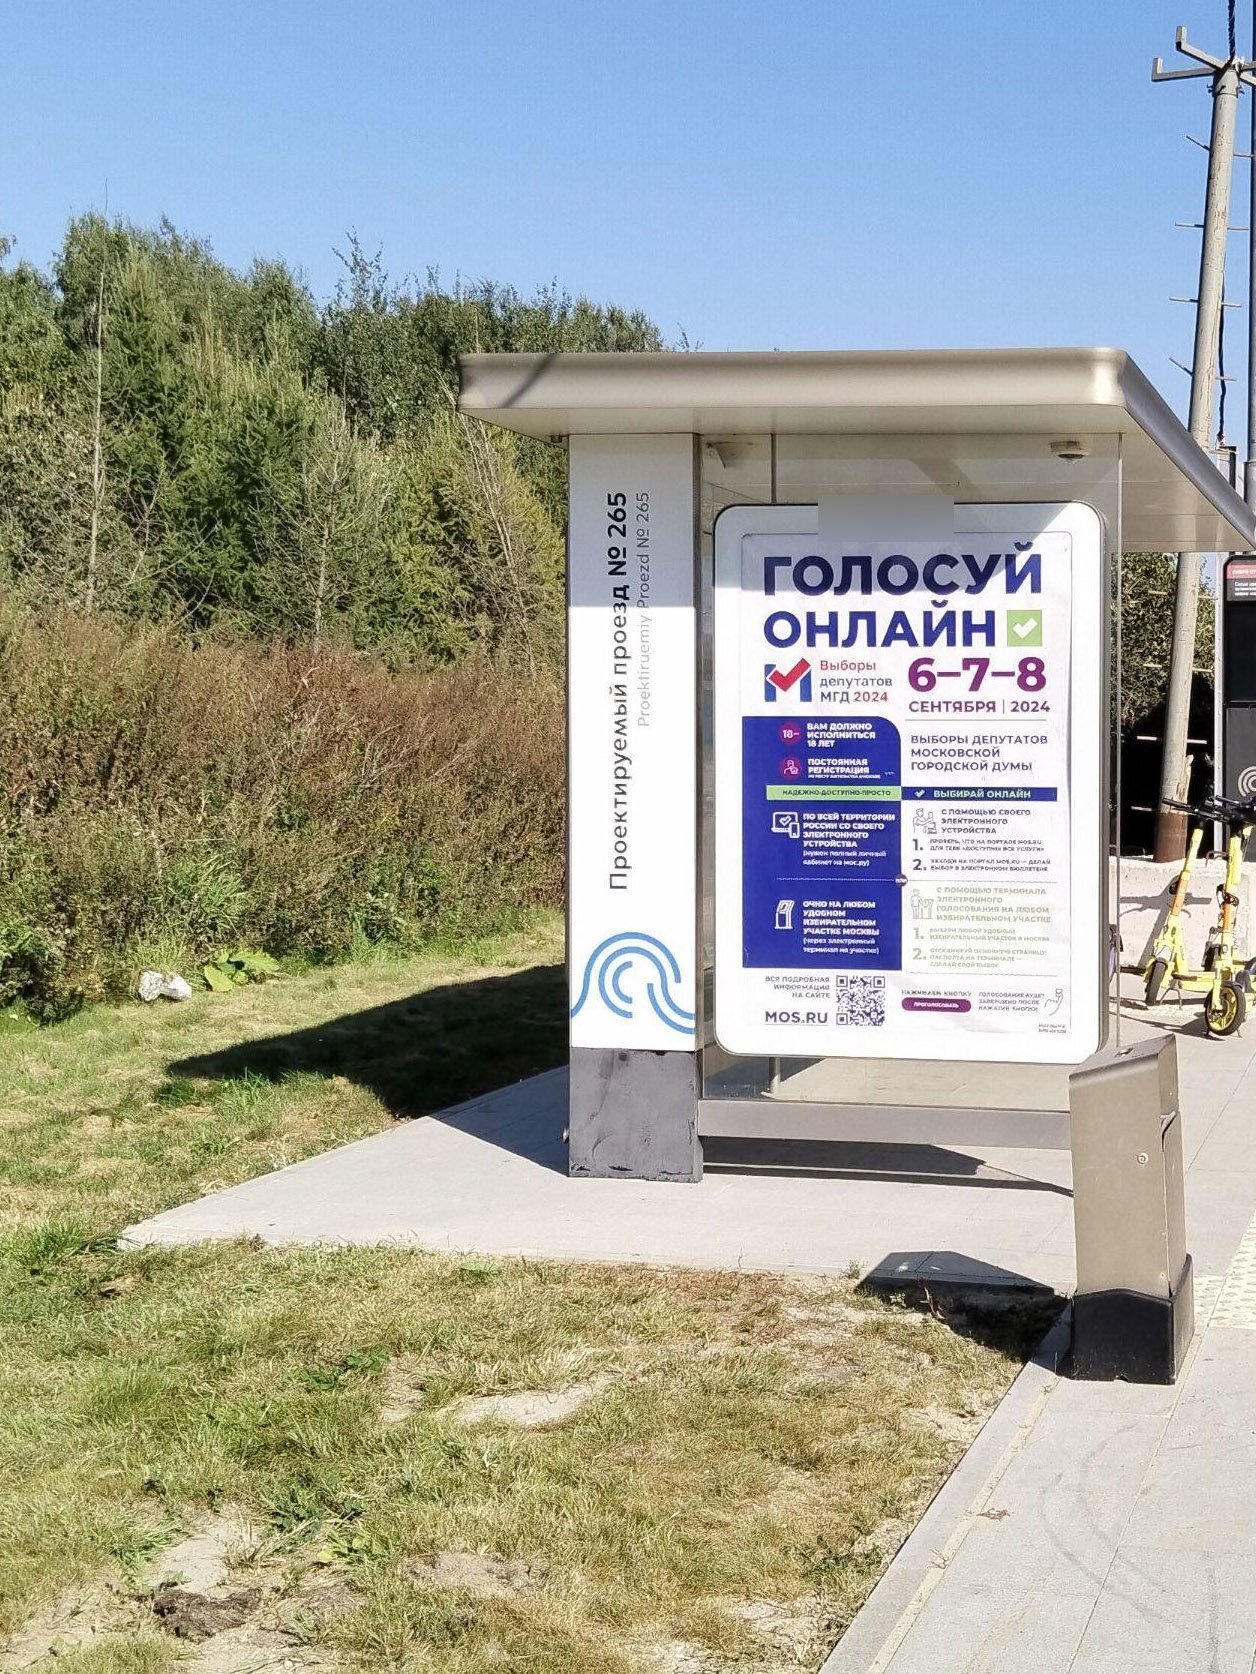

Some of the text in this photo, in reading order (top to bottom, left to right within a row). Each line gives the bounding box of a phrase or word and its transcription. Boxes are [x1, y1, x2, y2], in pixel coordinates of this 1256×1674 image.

[635, 492, 650, 523] 265
[636, 528, 650, 548] №
[763, 541, 1043, 597] ГОЛОСУЙ
[636, 553, 650, 608] Proezd
[763, 600, 996, 648] ОНЛАЙН
[820, 660, 876, 673] Выборы
[820, 677, 893, 689] депутатов
[607, 492, 632, 890] Проектируемый проезд № 265
[820, 691, 889, 704] МГД 2024
[908, 700, 1051, 713] СЕНТЯБРЯ 2024
[830, 723, 872, 731] ДОЛЖНО
[807, 731, 876, 739] ИСПОЛНИТЬСЯ
[911, 735, 1048, 746] ВЫБОРЫ ДЕПУТАТОВ
[911, 746, 1000, 757] МОСКОВСКОЙ
[807, 766, 870, 775] РЕГИСТРАЦИЯ
[911, 760, 1032, 773] ГОРОДСКОЙ ДУМЫ
[934, 789, 1031, 799] ВЫБИРАЙ ОНЛАЙН
[840, 813, 895, 821] ТЕРРИТОРИИ
[949, 808, 997, 816] ПОМОЩЬЮ
[941, 826, 997, 834] УСТРОЙСТВА
[803, 840, 857, 848] УСТРОЙСТВА
[803, 910, 846, 918] УДОБНОМ
[764, 1011, 828, 1024] MOS.RU
